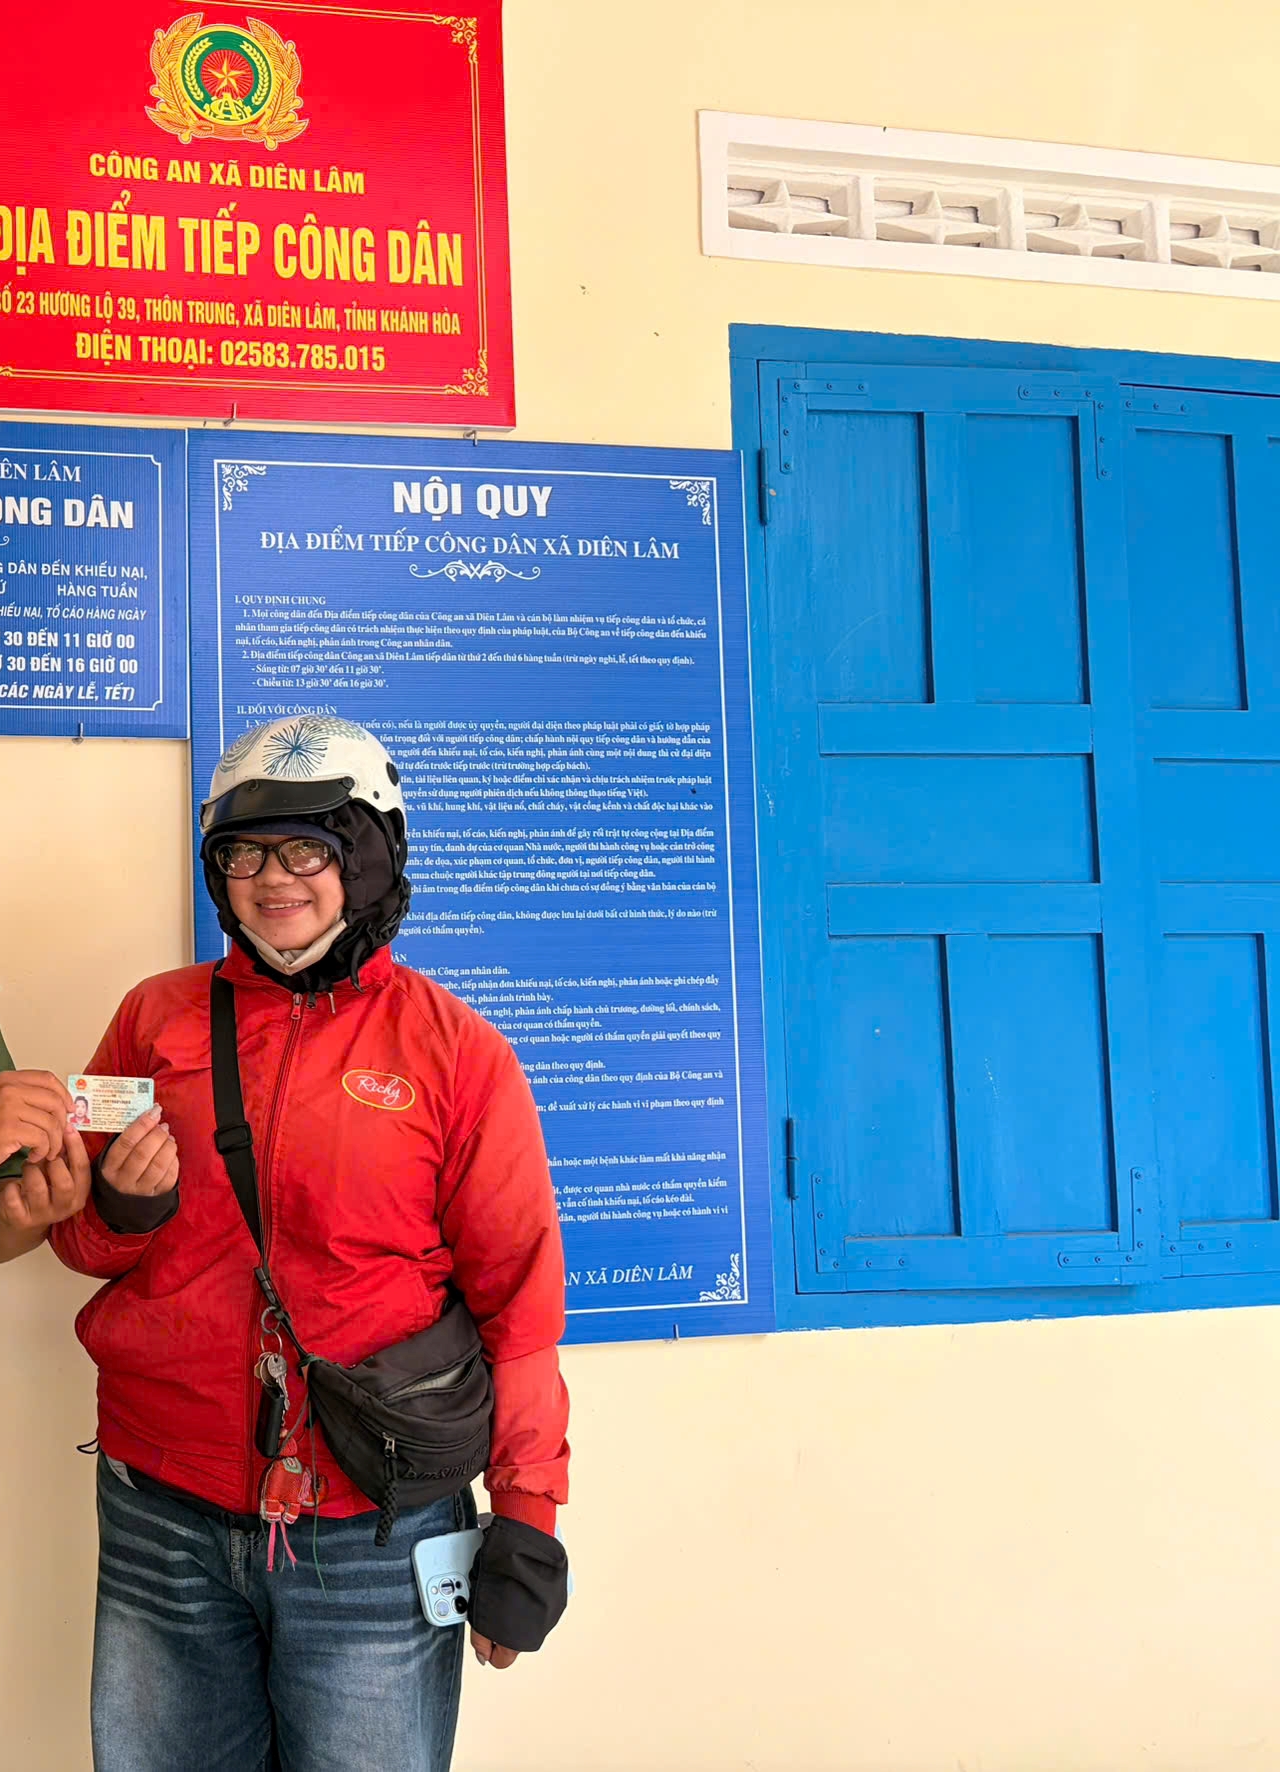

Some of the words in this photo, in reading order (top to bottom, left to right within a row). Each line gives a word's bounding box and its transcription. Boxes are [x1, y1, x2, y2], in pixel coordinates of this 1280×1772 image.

[90, 151, 158, 181] CÔNG
[166, 159, 201, 184] AN
[209, 159, 242, 186] XÃ
[249, 162, 306, 191] DIÊN
[314, 166, 364, 194] LÂM
[66, 190, 166, 271] ĐIỂM
[178, 202, 260, 275] TIẾP
[274, 213, 375, 282] CÔNG
[388, 219, 463, 286] DÂN
[16, 291, 34, 315] 23
[39, 290, 90, 317] HƯƠNG
[95, 291, 113, 324] LỘ
[117, 297, 140, 323] 39,
[144, 294, 183, 323] THÔN
[187, 300, 239, 328] TRUNG,
[244, 299, 263, 326] XÃ
[267, 300, 301, 328] DIÊN
[305, 302, 340, 332] LÂM,
[344, 301, 377, 331] TỈNH
[380, 306, 429, 334] KHÁNH
[432, 307, 461, 335] HÒA
[75, 328, 131, 366] ĐIỆN
[138, 336, 213, 370] THOẠI:
[221, 340, 385, 372] 02583.785.015
[34, 460, 81, 482] LÂM
[64, 494, 133, 529] DÂN
[393, 476, 462, 521] NỘI
[477, 484, 552, 519] QUY
[260, 531, 300, 554] ĐỊA
[306, 524, 364, 551] ĐIỂM
[369, 526, 419, 552] TIẾP
[425, 530, 486, 553] CÔNG
[493, 532, 536, 554] DÂN
[543, 534, 571, 555] XÃ
[578, 535, 627, 557] DIÊN
[634, 537, 678, 559] LÂM
[8, 559, 37, 575] DÂN
[41, 559, 70, 576] ĐẾN
[75, 560, 117, 578] KHIẾU
[121, 566, 148, 580] NẠI,
[57, 581, 96, 597] HÀNG
[100, 581, 138, 599] TUẦN
[23, 606, 42, 619] NẠI,
[46, 603, 60, 618] TỐ
[62, 605, 84, 619] CÁO
[86, 605, 116, 620] HÀNG
[117, 607, 147, 621] NGÀY
[4, 631, 22, 646] 30
[27, 627, 58, 647] ĐẾN
[63, 632, 80, 648] 11
[86, 629, 113, 649] GIỜ
[116, 634, 135, 649] 00
[7, 656, 26, 671] 30
[30, 652, 61, 672] ĐẾN
[66, 657, 85, 673] 16
[89, 654, 116, 673] GIỜ
[119, 658, 138, 674] 00
[32, 682, 74, 699] NGÀY
[77, 681, 99, 701] LỄ,
[104, 682, 135, 702] TẾT)
[356, 1075, 401, 1106] Richy
[585, 1267, 607, 1285] XÃ
[612, 1265, 653, 1283] DIÊN
[657, 1263, 693, 1281] LÂM
